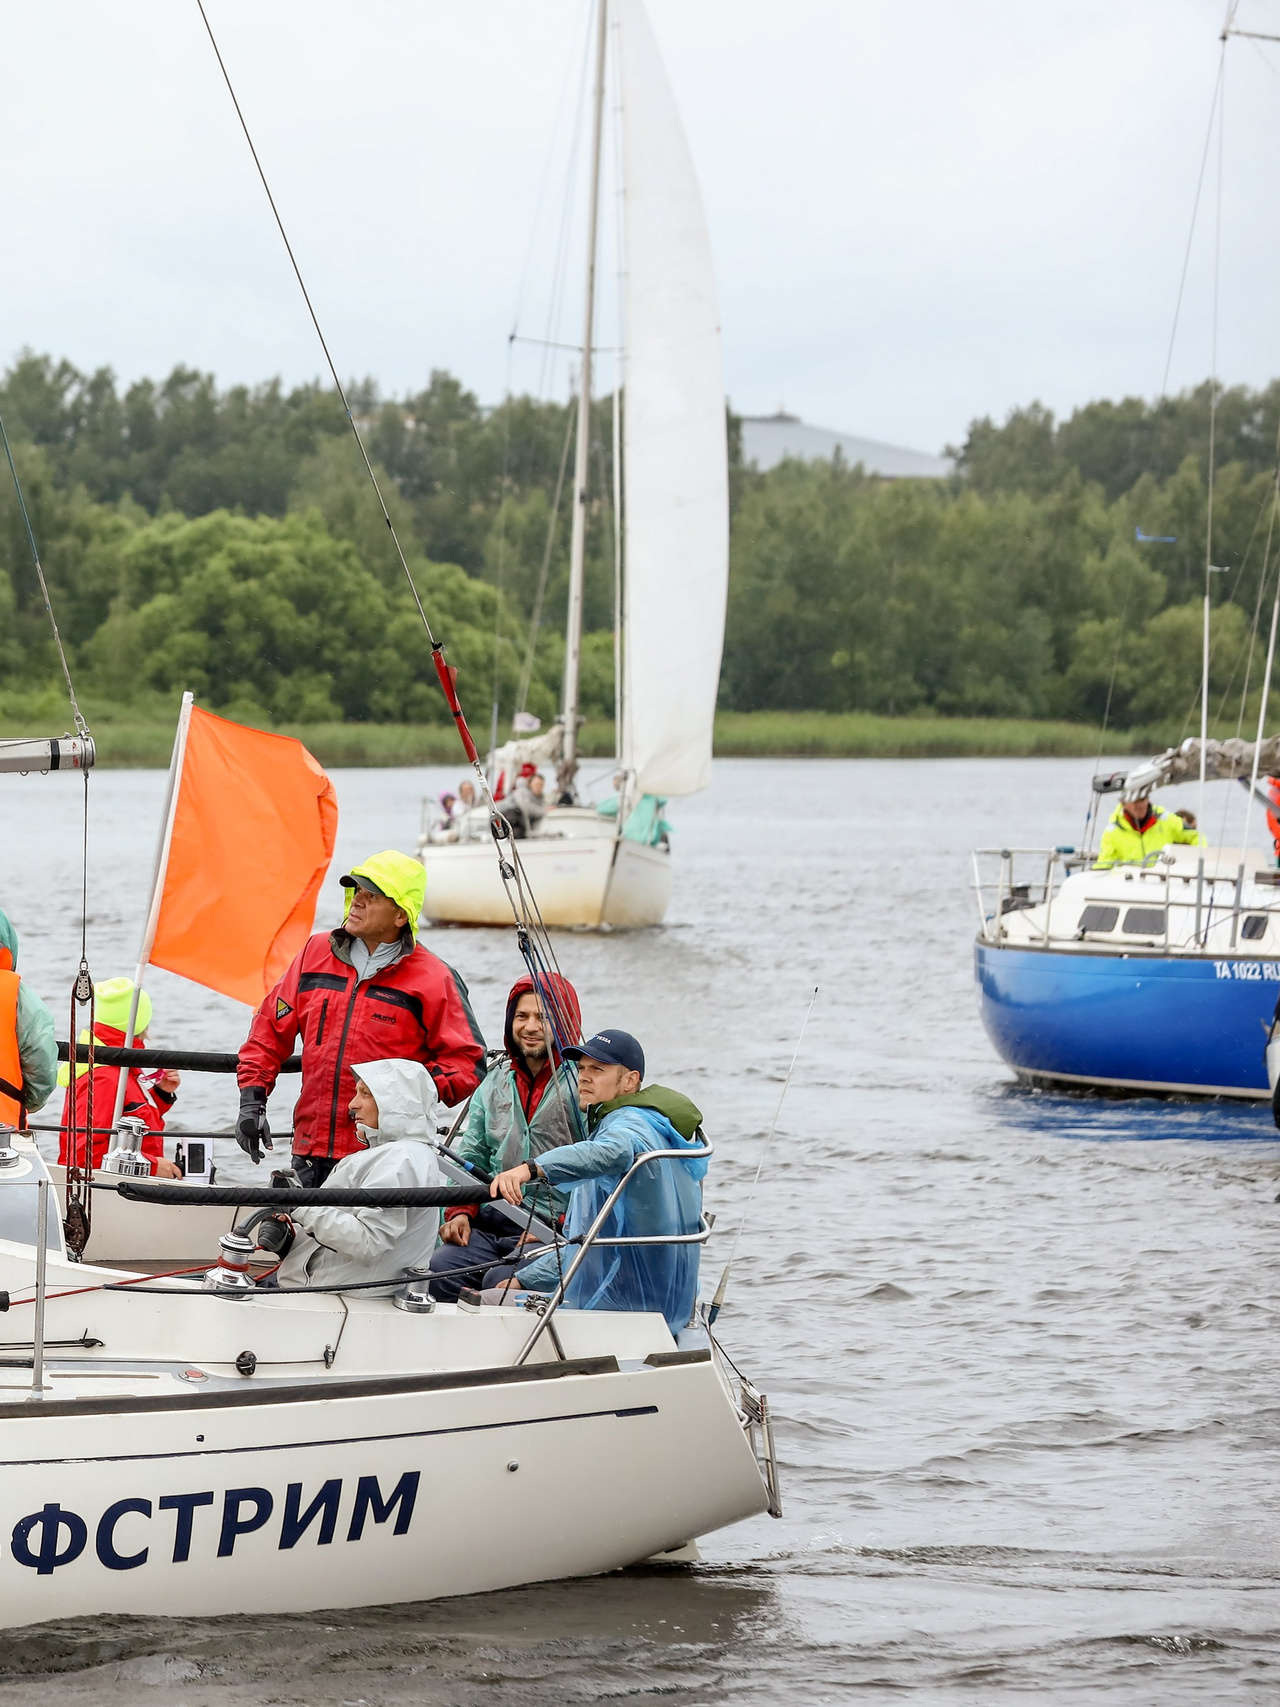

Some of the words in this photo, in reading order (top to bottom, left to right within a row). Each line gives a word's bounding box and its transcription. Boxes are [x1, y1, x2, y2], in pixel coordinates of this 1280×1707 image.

[1214, 961, 1231, 979] TA
[1232, 962, 1261, 980] 1022
[371, 1013, 397, 1024] MUSTO
